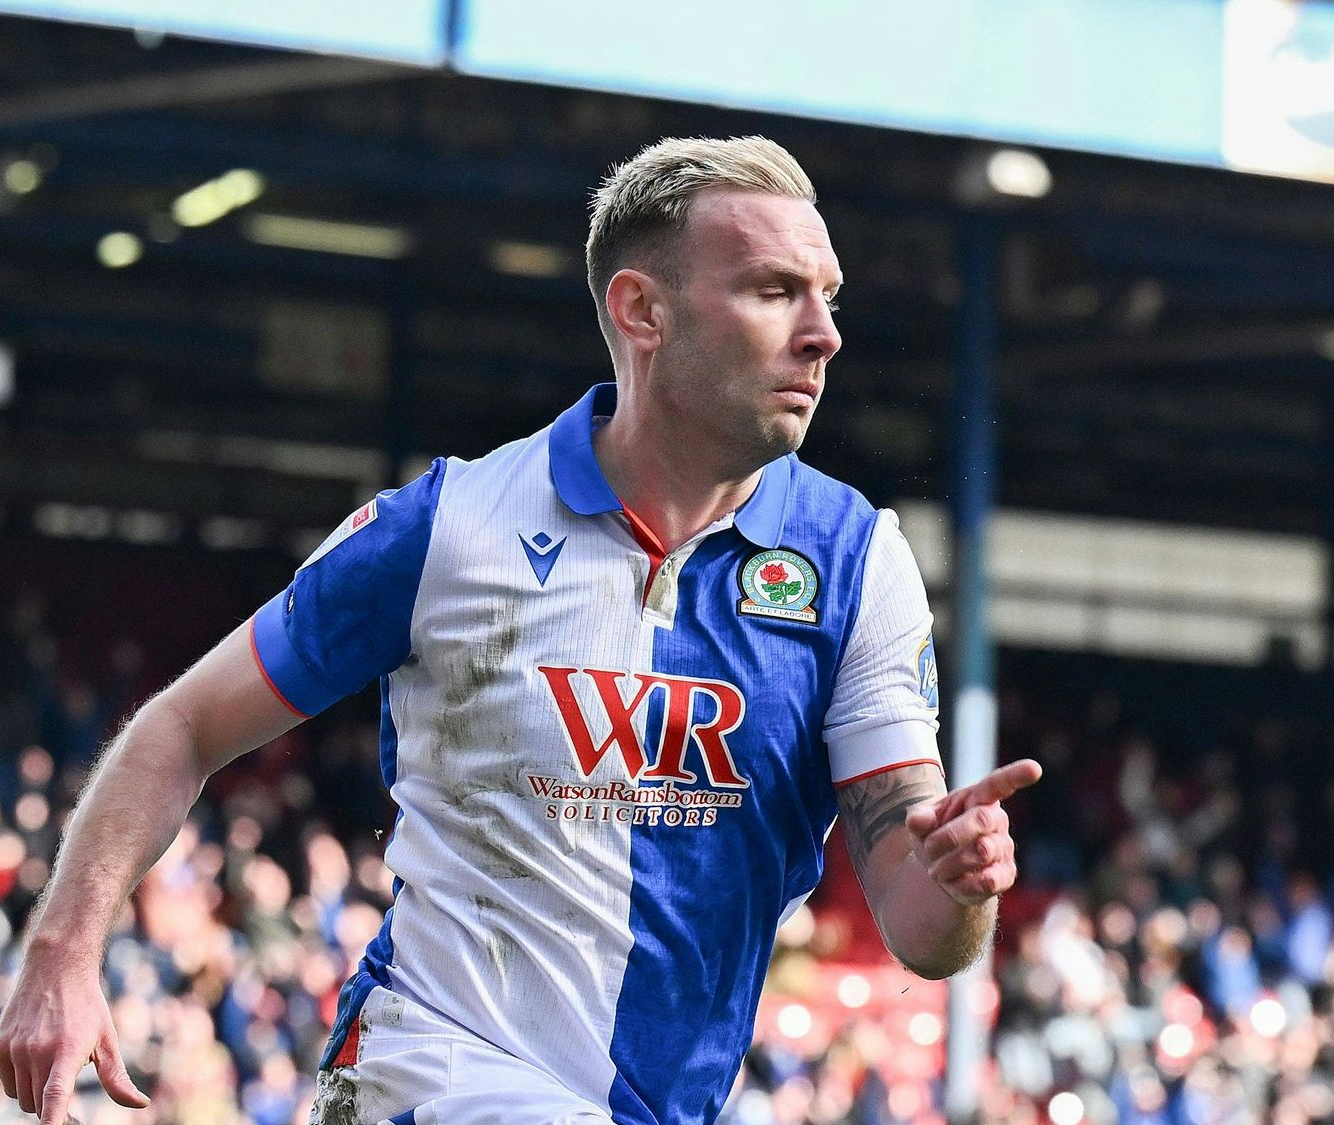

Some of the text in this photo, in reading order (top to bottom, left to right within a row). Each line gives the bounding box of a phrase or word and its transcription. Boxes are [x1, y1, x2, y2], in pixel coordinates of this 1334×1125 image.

[744, 552, 779, 593] BLACKBURN
[782, 553, 813, 582] ROVERS
[537, 665, 750, 787] WR
[526, 774, 742, 807] WatsonRamsbottom
[546, 804, 718, 826] SOLICITORS
